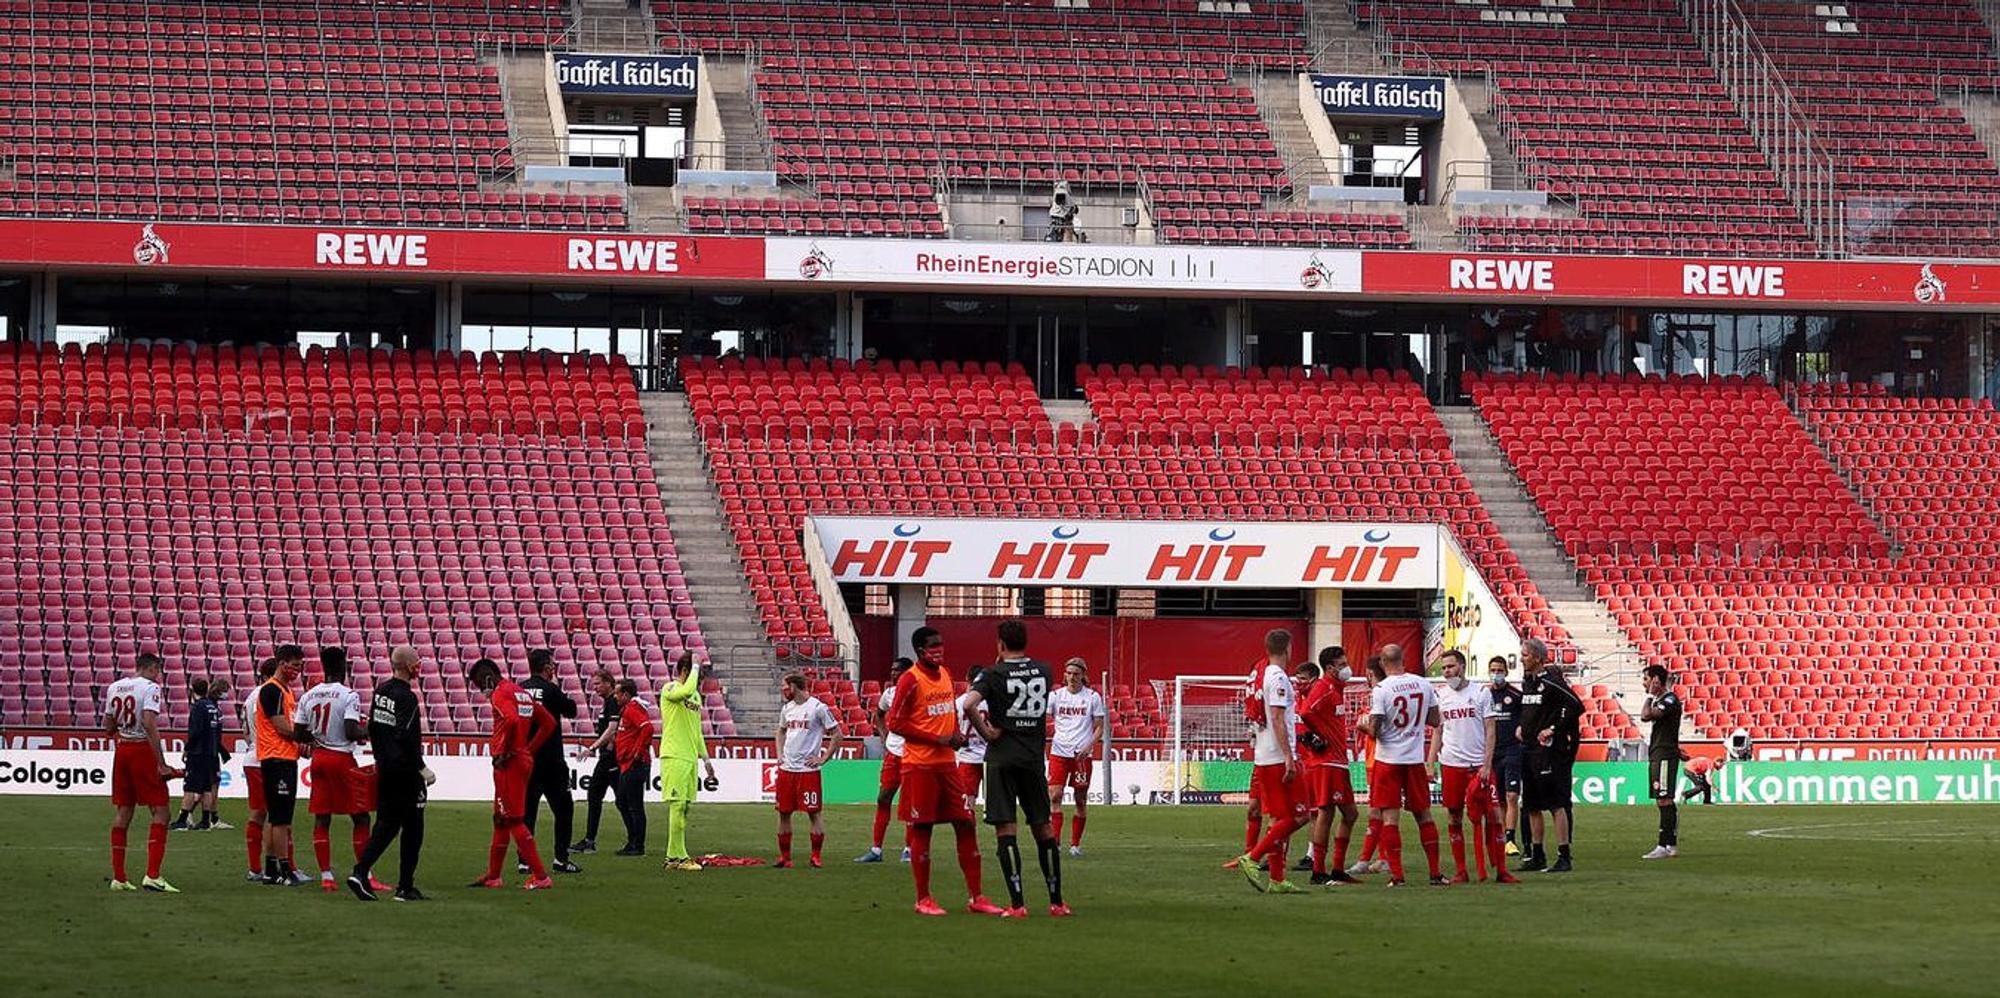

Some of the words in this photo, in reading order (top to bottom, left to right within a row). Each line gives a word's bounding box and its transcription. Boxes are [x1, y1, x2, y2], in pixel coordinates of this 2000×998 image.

[555, 59, 619, 87] Gaffel
[623, 61, 695, 90] Kölsch
[1374, 82, 1443, 111] Kölsch
[316, 232, 428, 267] REWE
[567, 238, 679, 272] REWE
[916, 252, 1154, 280] RheinEnergieSTADION
[1449, 259, 1554, 291] REWE
[1682, 264, 1786, 297] REWE
[833, 539, 952, 577] HIT
[988, 541, 1110, 579] HIT
[1146, 544, 1266, 582] HIT
[1301, 545, 1420, 582] HIT
[1006, 676, 1047, 718] 28
[1059, 706, 1087, 716] REWE
[1393, 692, 1424, 728] 37
[312, 701, 332, 737] 11
[1443, 707, 1475, 721] REWE
[1074, 770, 1087, 784] 33
[803, 791, 818, 805] 30
